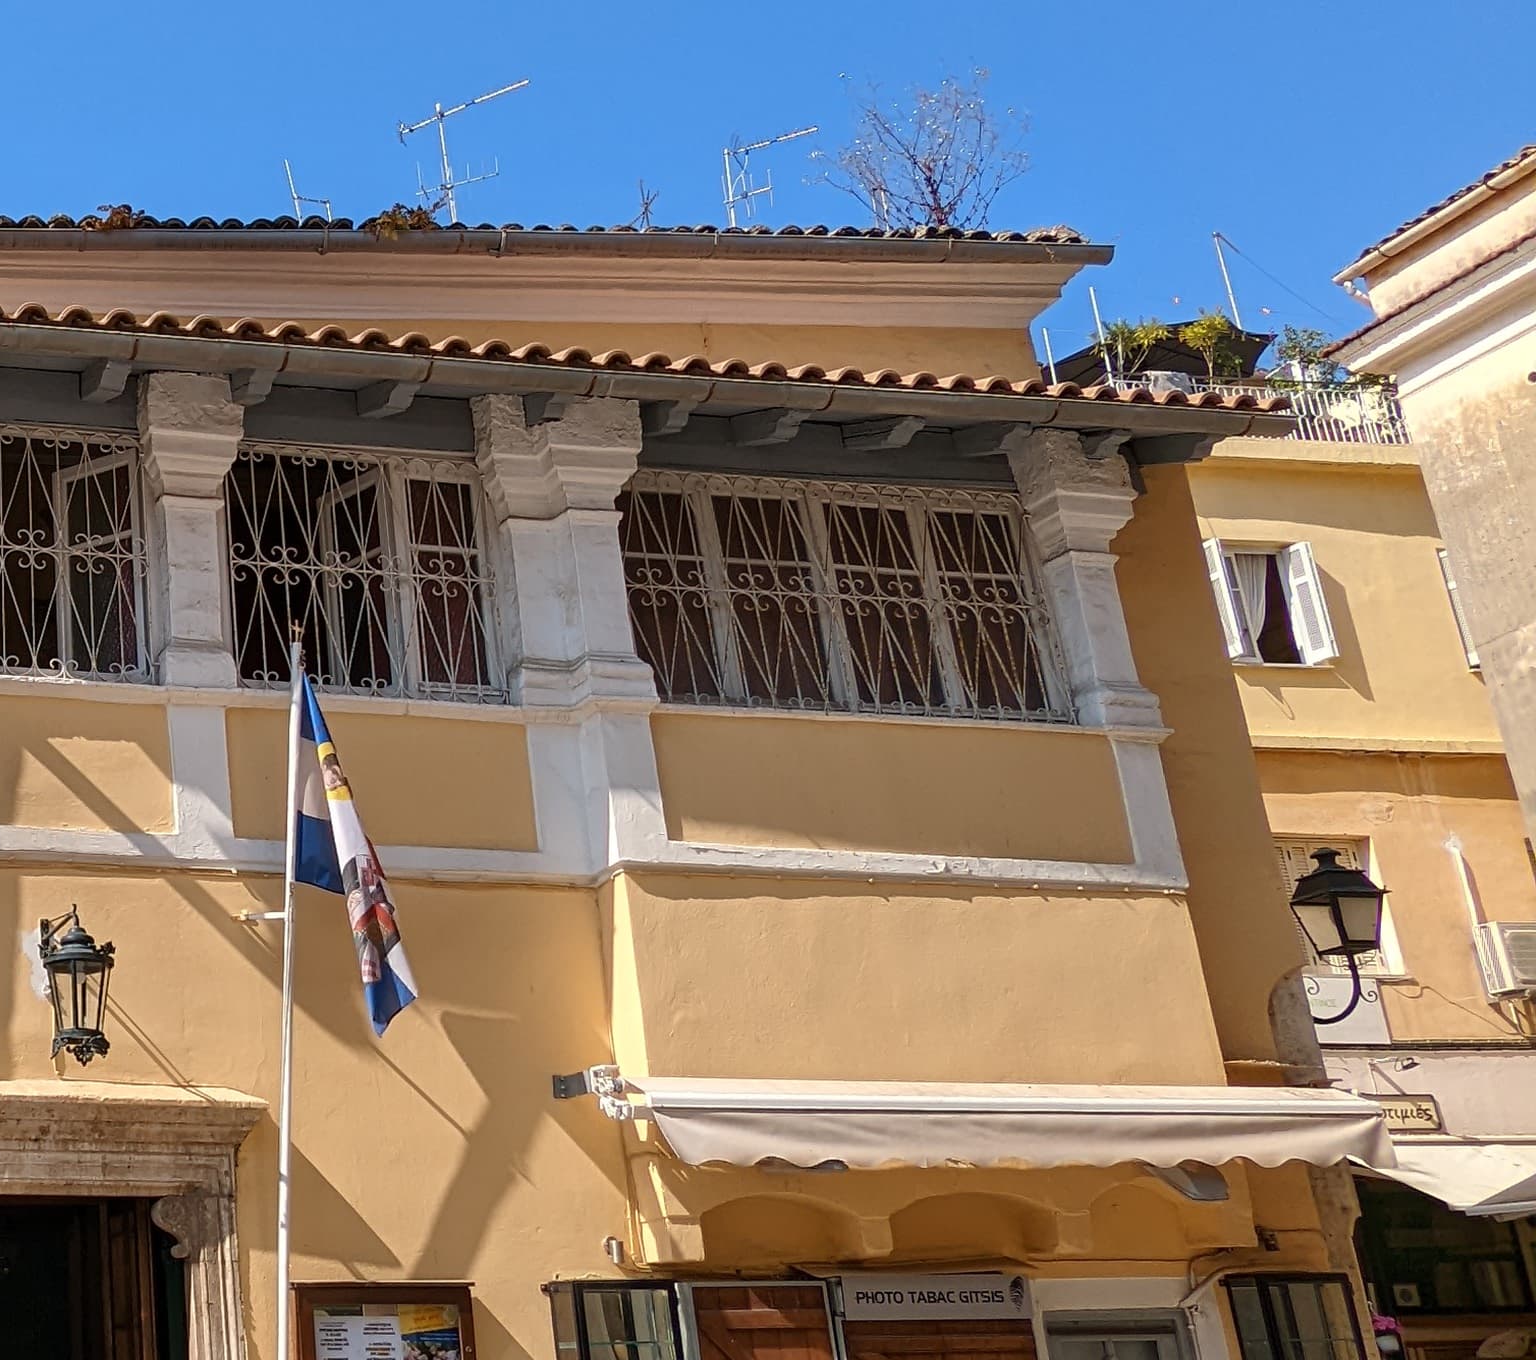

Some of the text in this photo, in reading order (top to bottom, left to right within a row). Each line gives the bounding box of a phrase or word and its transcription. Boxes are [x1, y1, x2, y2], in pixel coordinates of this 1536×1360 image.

[856, 1289, 1005, 1305] PHOTO TABAC GITSIS
